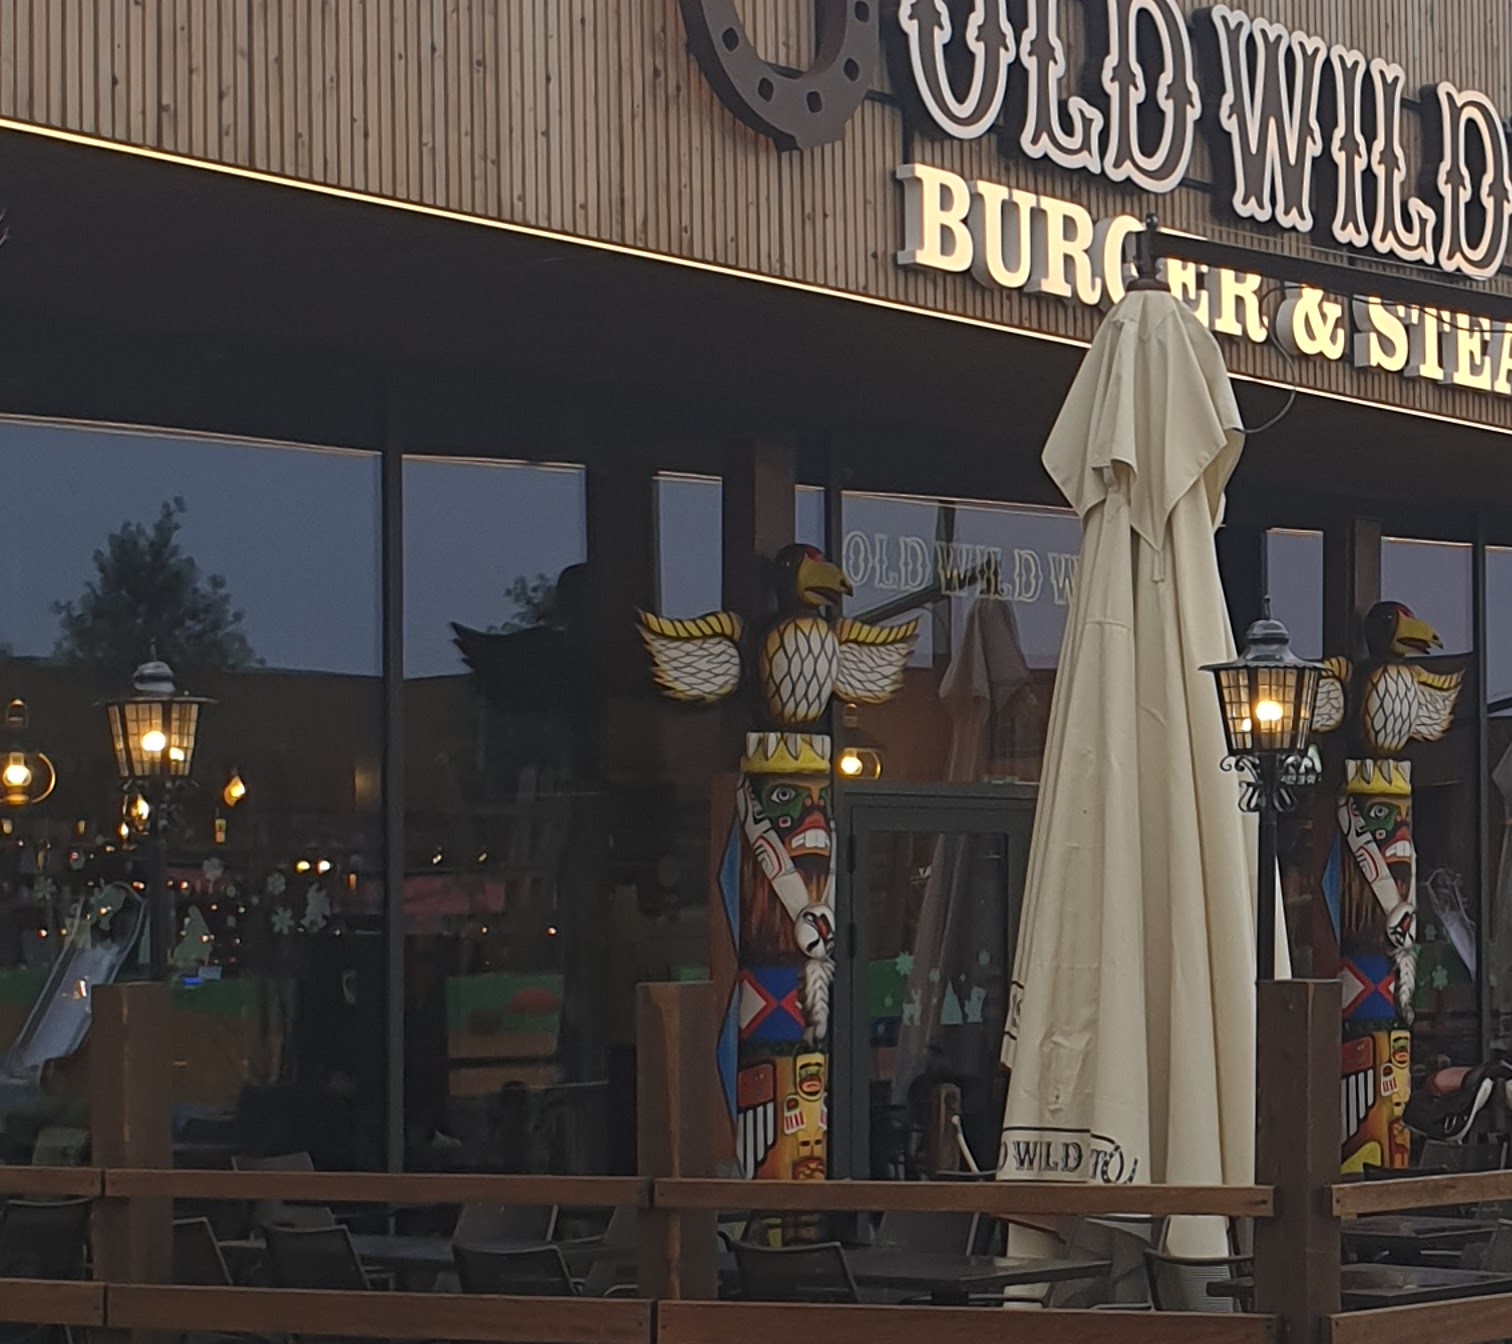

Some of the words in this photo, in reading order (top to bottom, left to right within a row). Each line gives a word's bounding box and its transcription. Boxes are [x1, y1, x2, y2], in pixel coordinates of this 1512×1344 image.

[1291, 284, 1345, 361] &
[843, 530, 930, 592] OLD
[935, 541, 1044, 604] WILD
